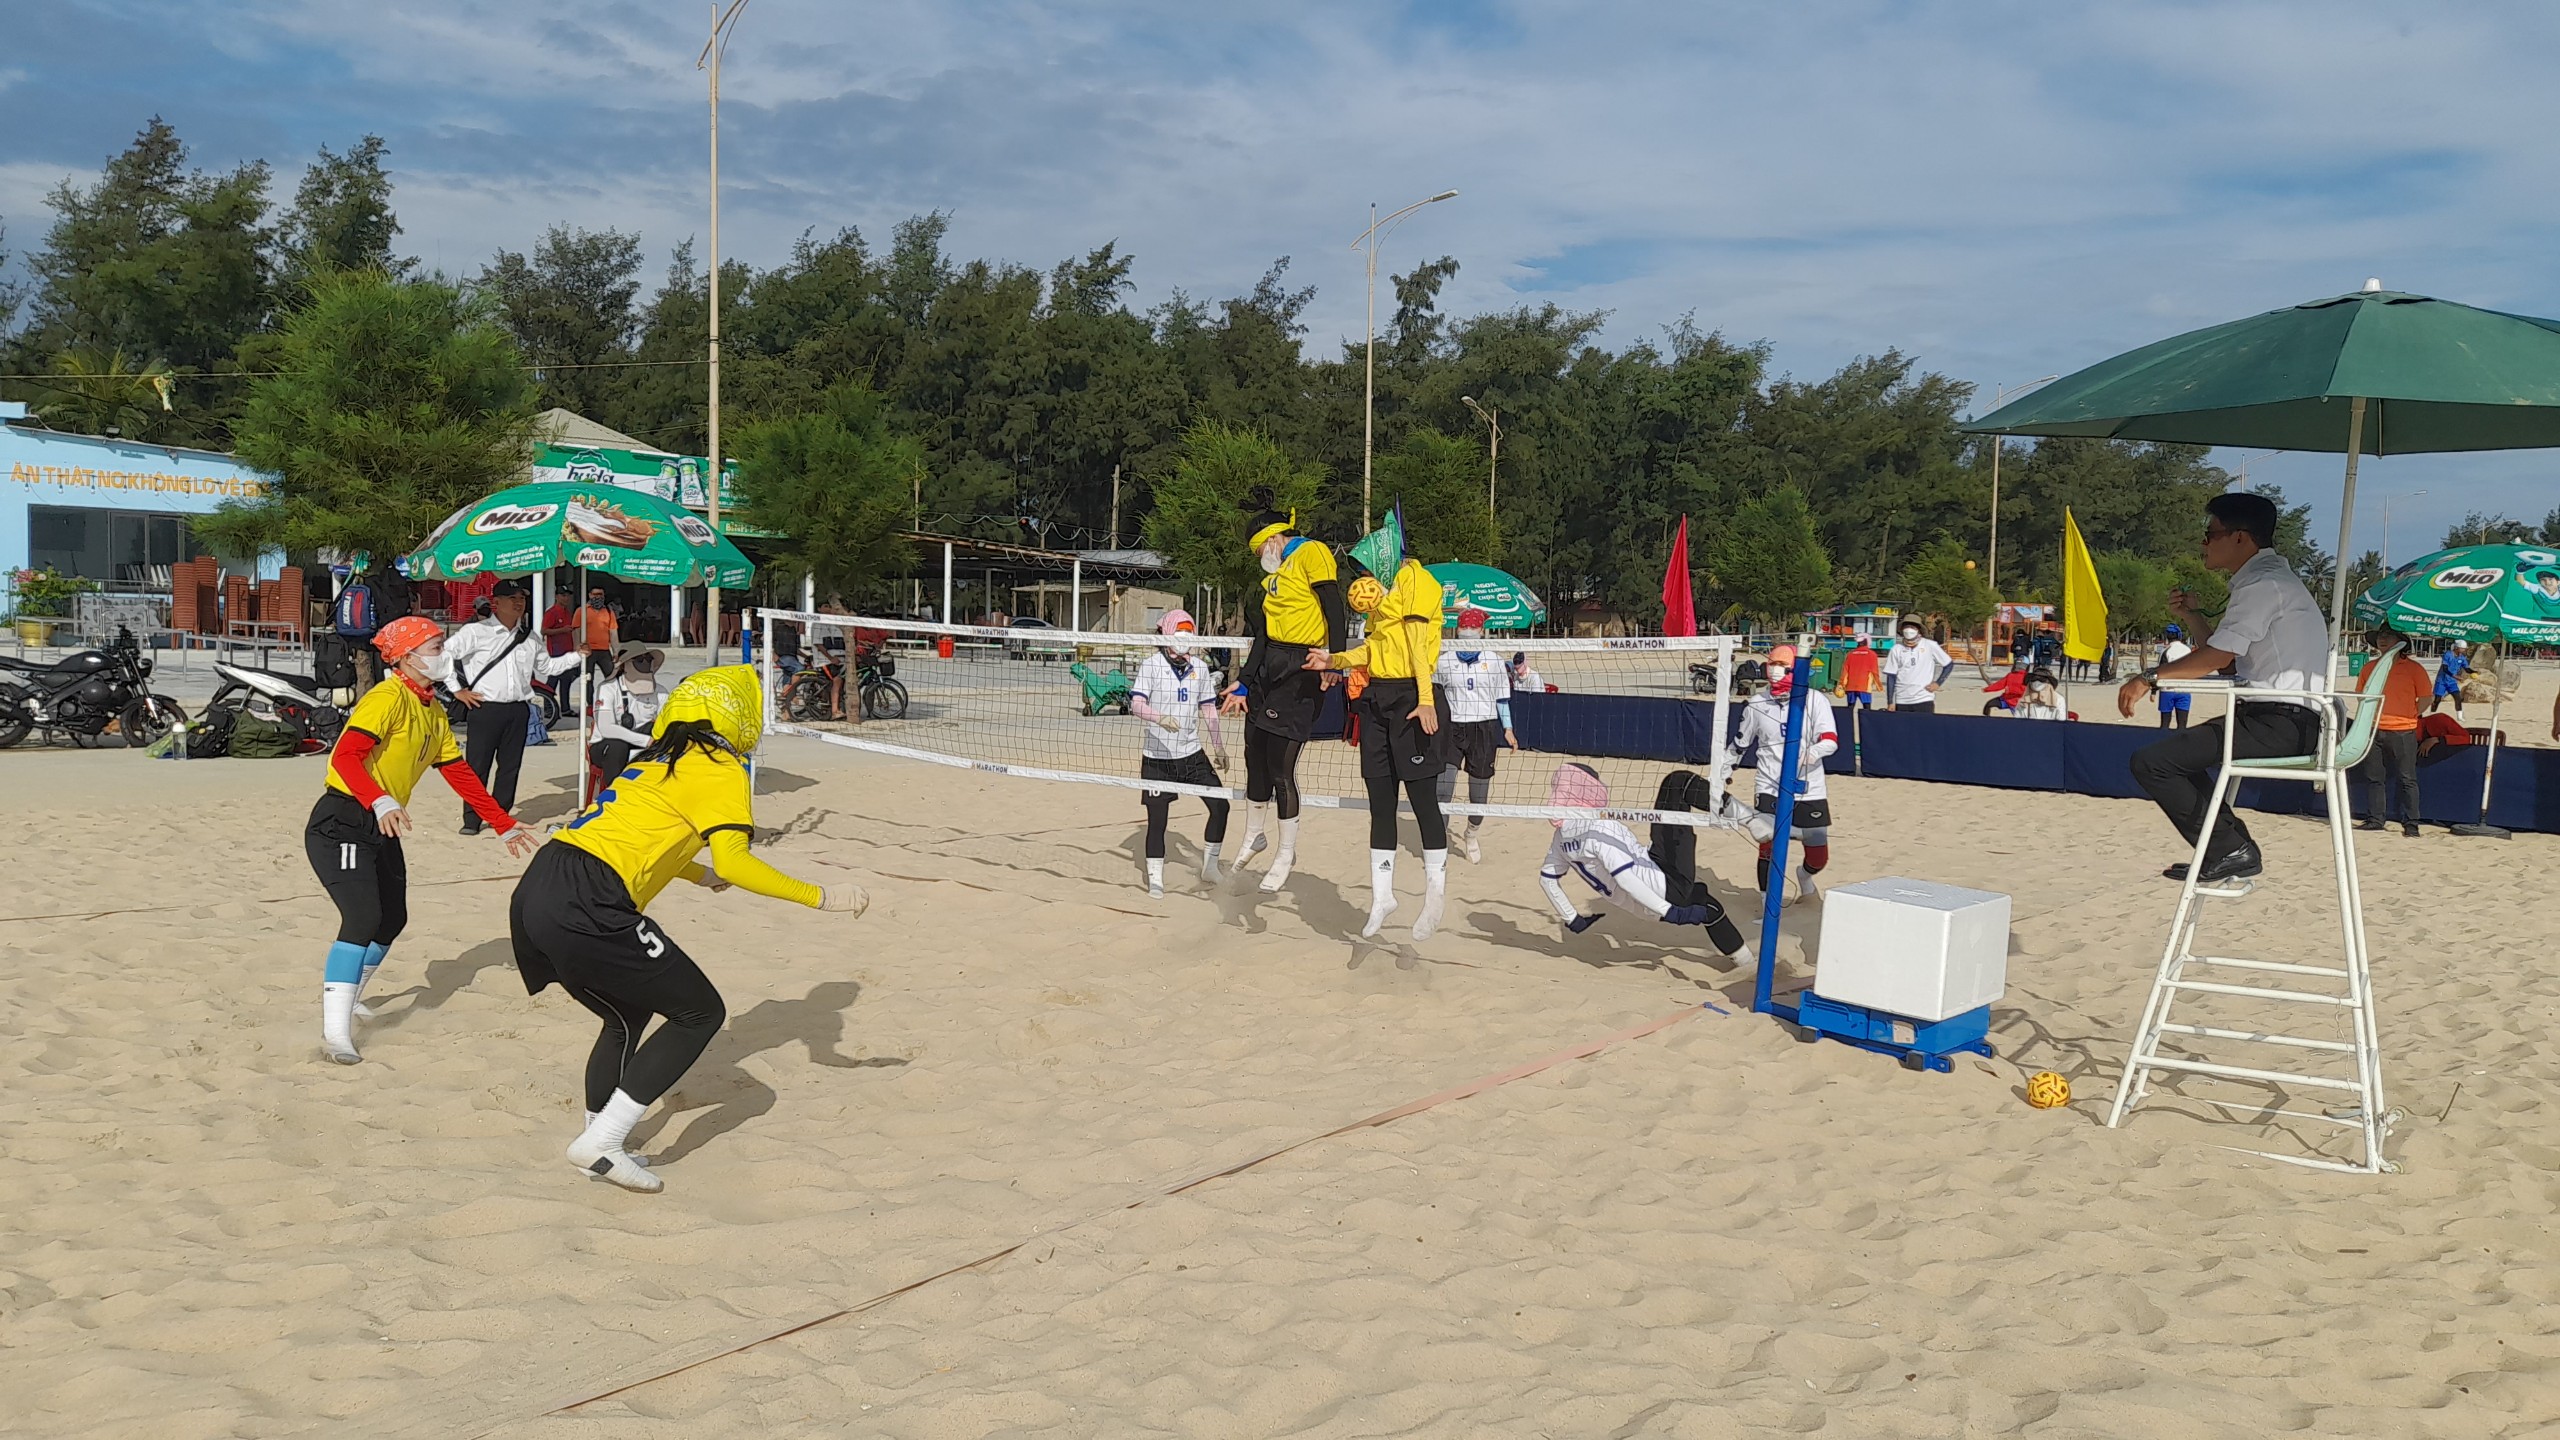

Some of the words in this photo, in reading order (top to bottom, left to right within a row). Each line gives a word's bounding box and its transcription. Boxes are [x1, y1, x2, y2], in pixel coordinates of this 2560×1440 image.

[10, 461, 40, 484] ĂN
[97, 469, 124, 489] NO
[127, 470, 192, 493] KHÔNG
[193, 476, 216, 495] LO
[480, 511, 548, 527] MILO
[677, 523, 710, 538] MILO
[456, 555, 480, 568] MILO
[580, 552, 607, 562] MILO
[2439, 571, 2496, 585] MILO
[794, 614, 821, 622] MARATHON
[2397, 614, 2423, 622] MILO
[2423, 615, 2453, 626] NĂNG
[2453, 620, 2489, 632] LƯỢNG
[976, 628, 1009, 637] MARATHON
[2511, 627, 2538, 635] MILO
[2538, 625, 2560, 635] NĂN
[1610, 639, 1665, 649] MARATHON
[1467, 678, 1474, 691] 9
[1177, 687, 1188, 702] 16
[418, 734, 431, 762] 11
[976, 763, 1008, 773] MARATHON
[1607, 811, 1662, 822] MARATHON
[340, 843, 357, 870] 11
[635, 918, 665, 959] 5
